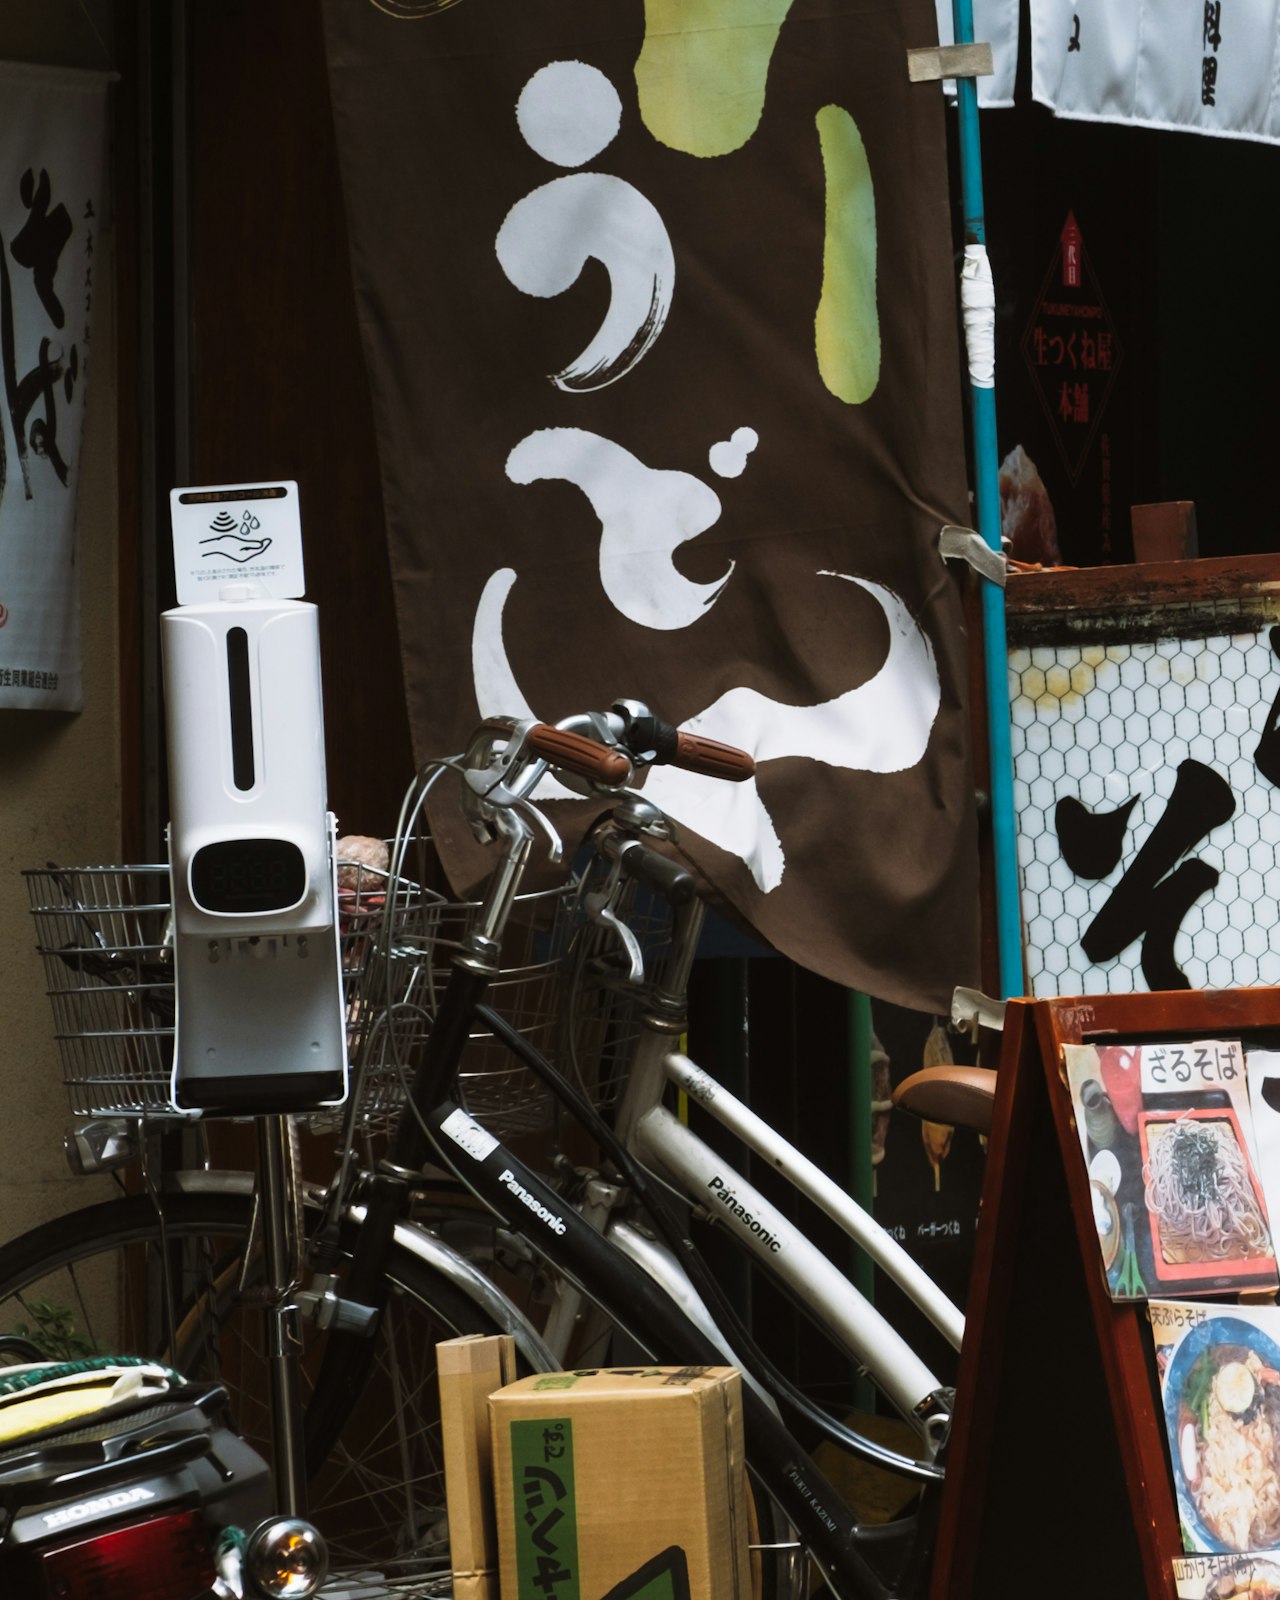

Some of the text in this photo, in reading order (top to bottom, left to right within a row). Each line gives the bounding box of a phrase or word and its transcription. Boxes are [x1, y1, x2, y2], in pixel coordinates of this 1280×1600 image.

[1147, 1047, 1241, 1085] ざるそば
[499, 1168, 567, 1237] Panasonic
[707, 1176, 782, 1254] Panasonic
[1151, 1306, 1208, 1331] 天ぷらそば
[42, 1487, 156, 1529] HONDA
[789, 1469, 837, 1533] FUKUI KAZUMI
